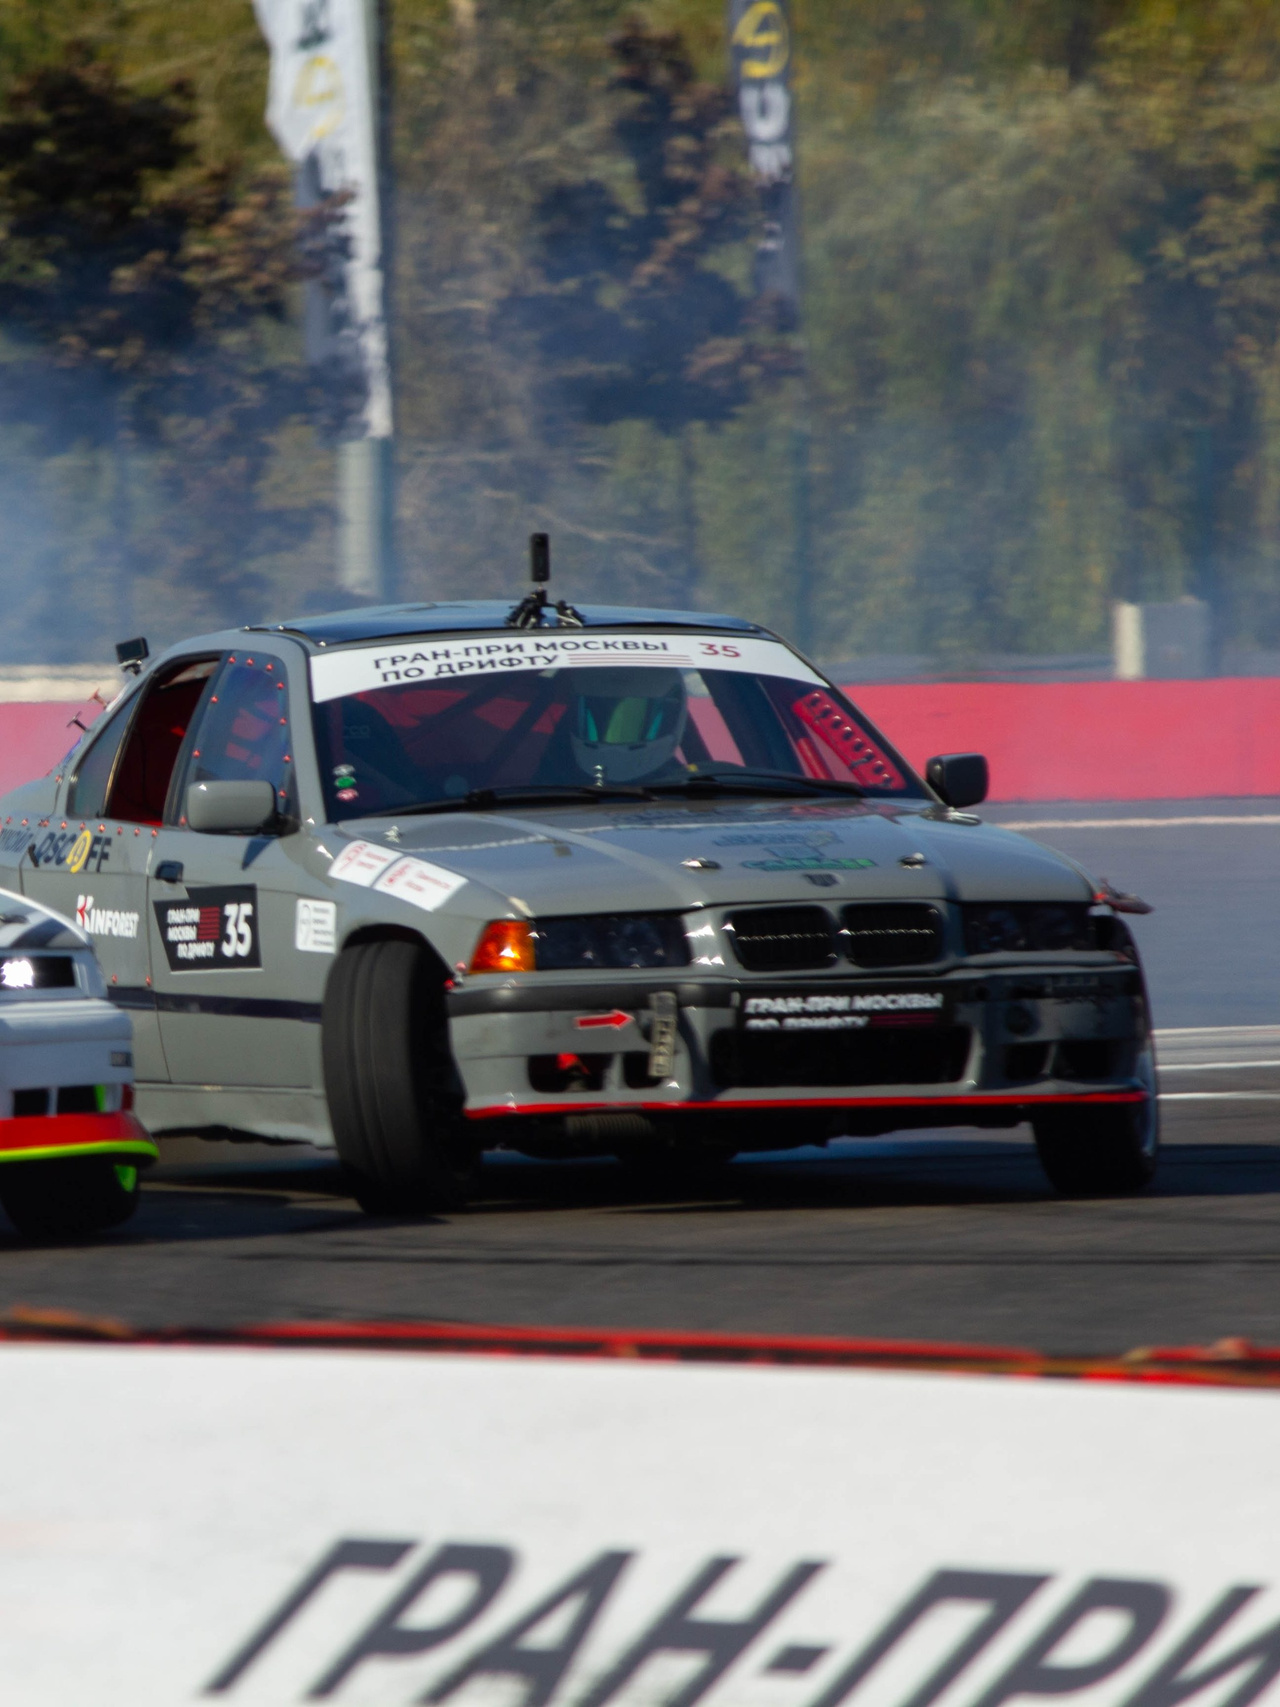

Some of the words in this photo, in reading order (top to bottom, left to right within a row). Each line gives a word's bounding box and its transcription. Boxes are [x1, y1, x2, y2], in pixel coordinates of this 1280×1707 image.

[374, 642, 525, 669] ГРАН-ПРИ
[535, 640, 669, 653] МОСКВЫ
[699, 642, 741, 659] 35
[382, 667, 424, 683] ПО
[434, 654, 558, 678] ДРИФТУ
[222, 903, 253, 958] 35
[745, 996, 851, 1014] ГРАН-ПРИ
[852, 993, 944, 1010] МОСКВЫ
[204, 1538, 1280, 1707] ГРАН-ПРИ
